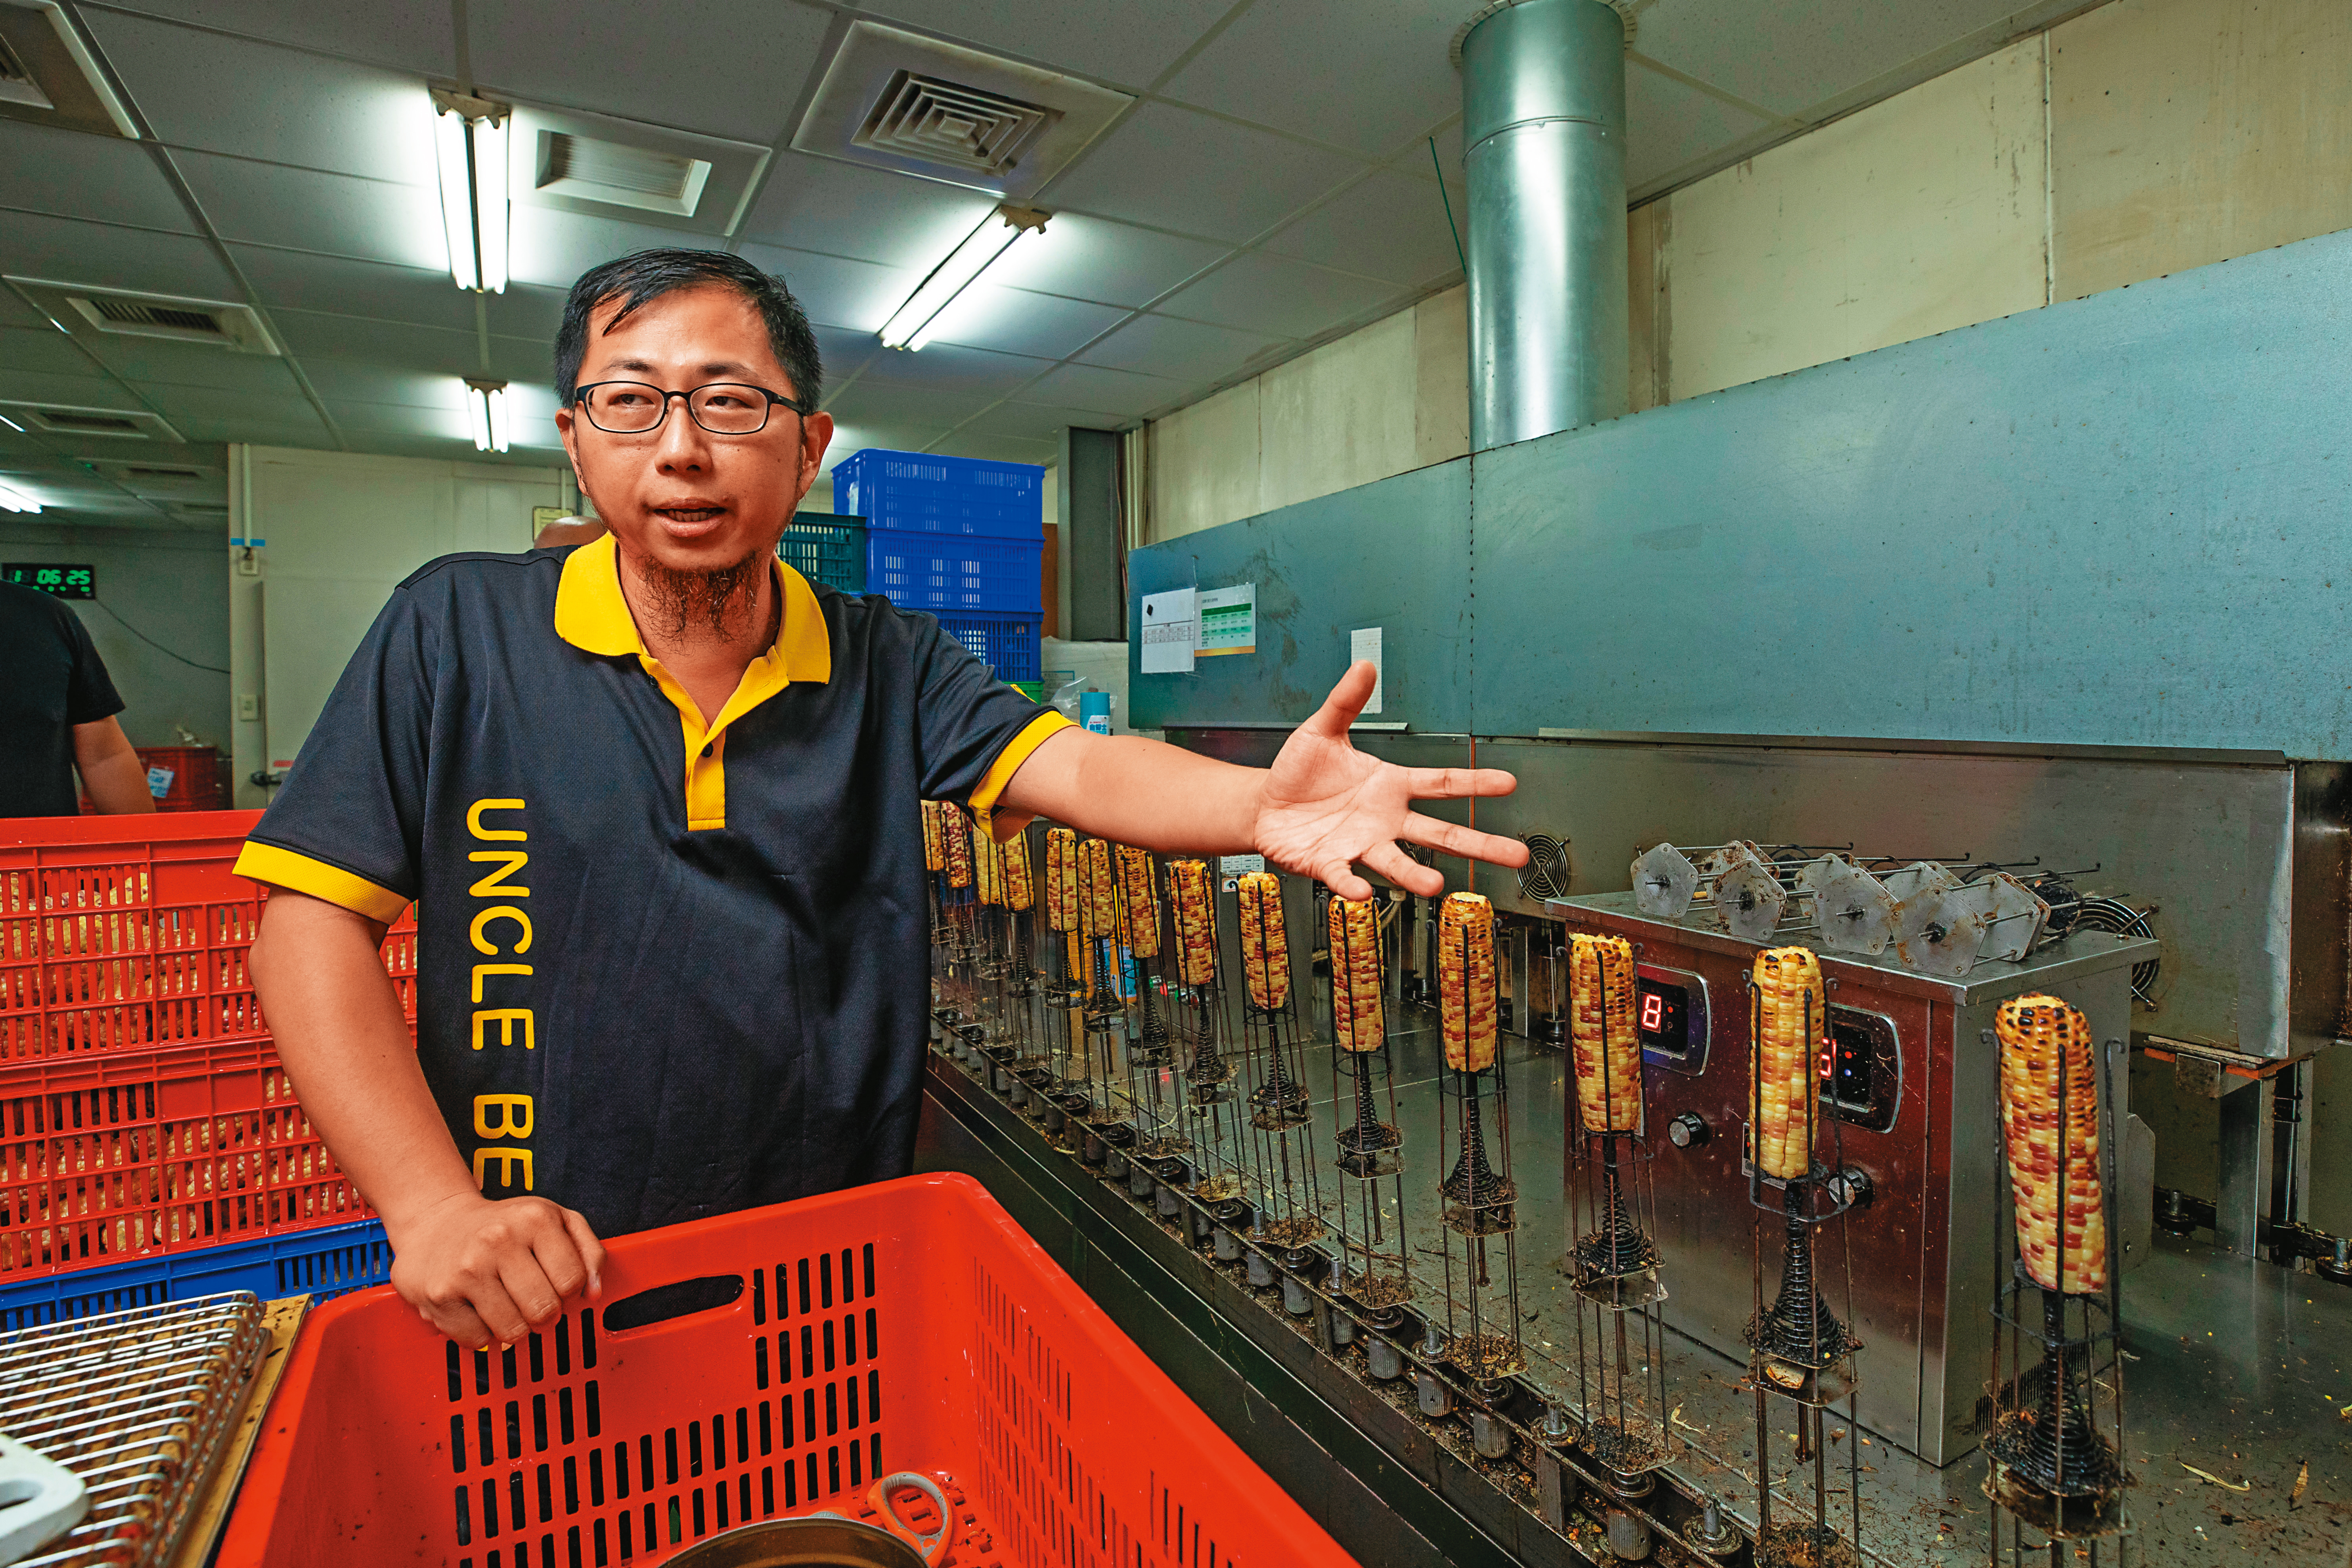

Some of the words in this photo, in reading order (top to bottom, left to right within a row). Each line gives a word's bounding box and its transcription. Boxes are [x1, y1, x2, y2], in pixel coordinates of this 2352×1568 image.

[37, 569, 61, 584] 06
[66, 570, 90, 585] 25
[467, 799, 534, 1049] UNCLE
[1642, 994, 1661, 1029] 8
